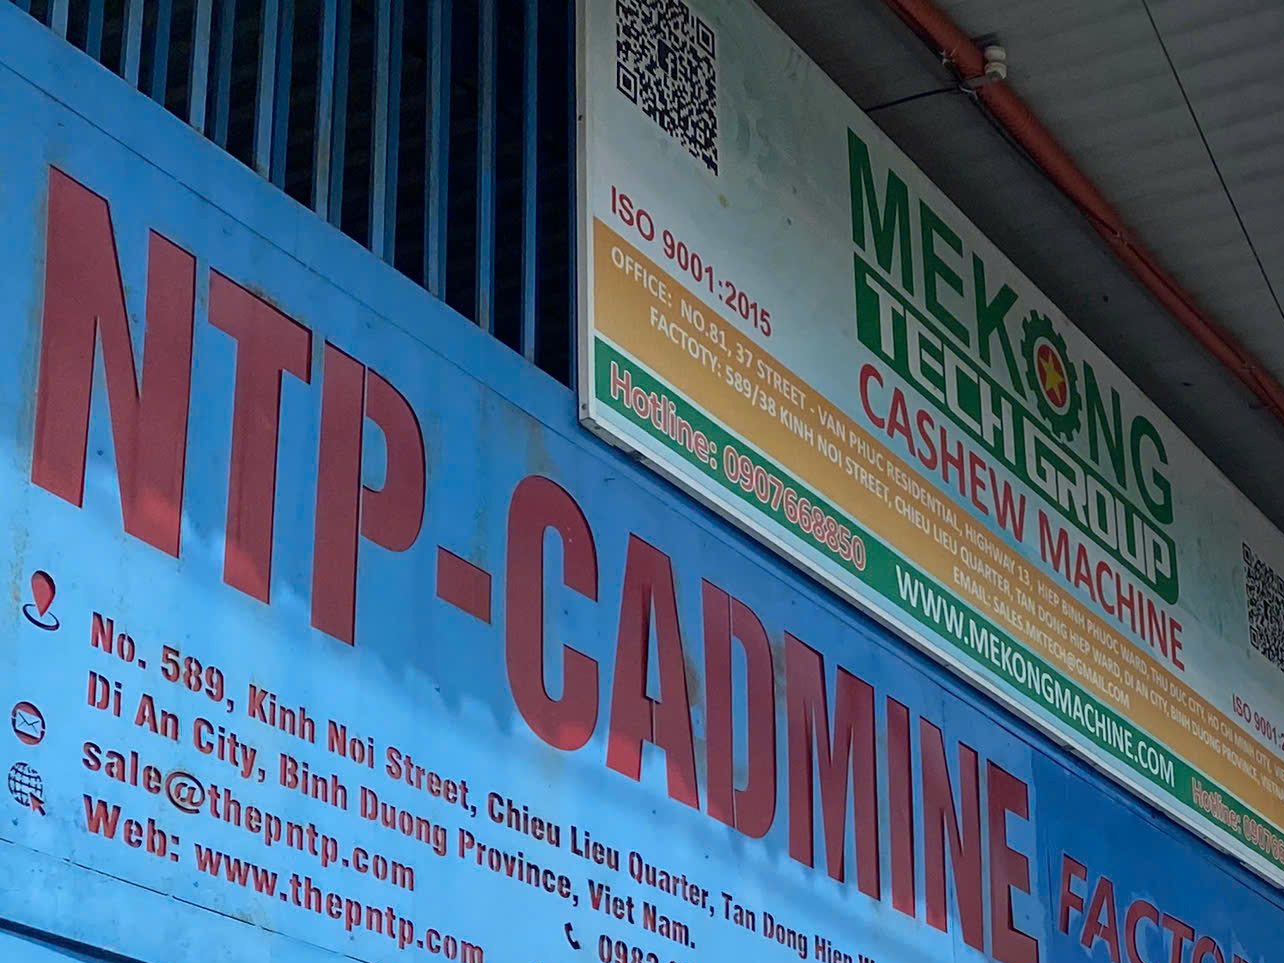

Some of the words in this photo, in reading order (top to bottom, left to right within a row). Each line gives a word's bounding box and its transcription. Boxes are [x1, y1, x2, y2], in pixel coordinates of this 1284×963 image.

[611, 185, 654, 241] ISO
[663, 230, 771, 337] 9001:2015
[848, 126, 1174, 525] MEKONG
[610, 361, 717, 469] Hotline:
[723, 445, 866, 571] 0907668850
[896, 564, 1175, 788] WWW.MEKONGMACHINE.COM
[611, 246, 672, 307] OFFICE:
[681, 299, 732, 357] NO.81,
[736, 343, 753, 367] 37
[757, 359, 806, 410] STREET
[818, 405, 845, 442] VAN
[850, 432, 884, 472] PHUC
[887, 460, 963, 538] RESIDENTIAL,
[965, 523, 1015, 572] HIGHWAY
[1038, 580, 1060, 607] HIEP
[1062, 602, 1085, 627] BINH
[1087, 620, 1118, 652] PHUOC
[1151, 667, 1168, 691] THU
[650, 306, 721, 377] FACTOTY:
[726, 366, 776, 417] 589/38
[780, 406, 813, 446] KINH
[818, 437, 842, 468] NOI
[846, 457, 891, 509] STREET,
[895, 495, 930, 535] CHIEU
[934, 523, 957, 555] LIEU
[960, 546, 1013, 599] QUARTER,
[1016, 588, 1035, 617] TAN
[1039, 608, 1067, 640] DONG
[1069, 628, 1091, 654] HIEP
[859, 363, 1026, 542] CASHEW
[1038, 509, 1185, 672] MACHINE
[90, 611, 147, 669] No.
[161, 644, 234, 713] 589,
[248, 684, 315, 744] Kinh
[327, 719, 374, 768] Noi
[386, 746, 477, 818] Street,
[487, 791, 560, 847] Chieu
[570, 825, 619, 871] Lieu
[628, 851, 714, 918] Quarter,
[722, 892, 755, 932] Tan
[763, 912, 807, 960] Dong
[993, 596, 1130, 710] SALES.MKTECH@GMAIL.COM
[1232, 693, 1252, 723] ISO
[83, 740, 415, 891] sale@thepntp.com
[83, 794, 180, 862] Web:
[87, 670, 121, 717] Di
[135, 693, 179, 741] An
[193, 717, 265, 783] City,
[279, 753, 347, 811] Binh
[360, 786, 447, 856] Duong
[458, 828, 578, 907] Province,
[588, 879, 634, 931] Viet
[643, 903, 696, 949] Nam.
